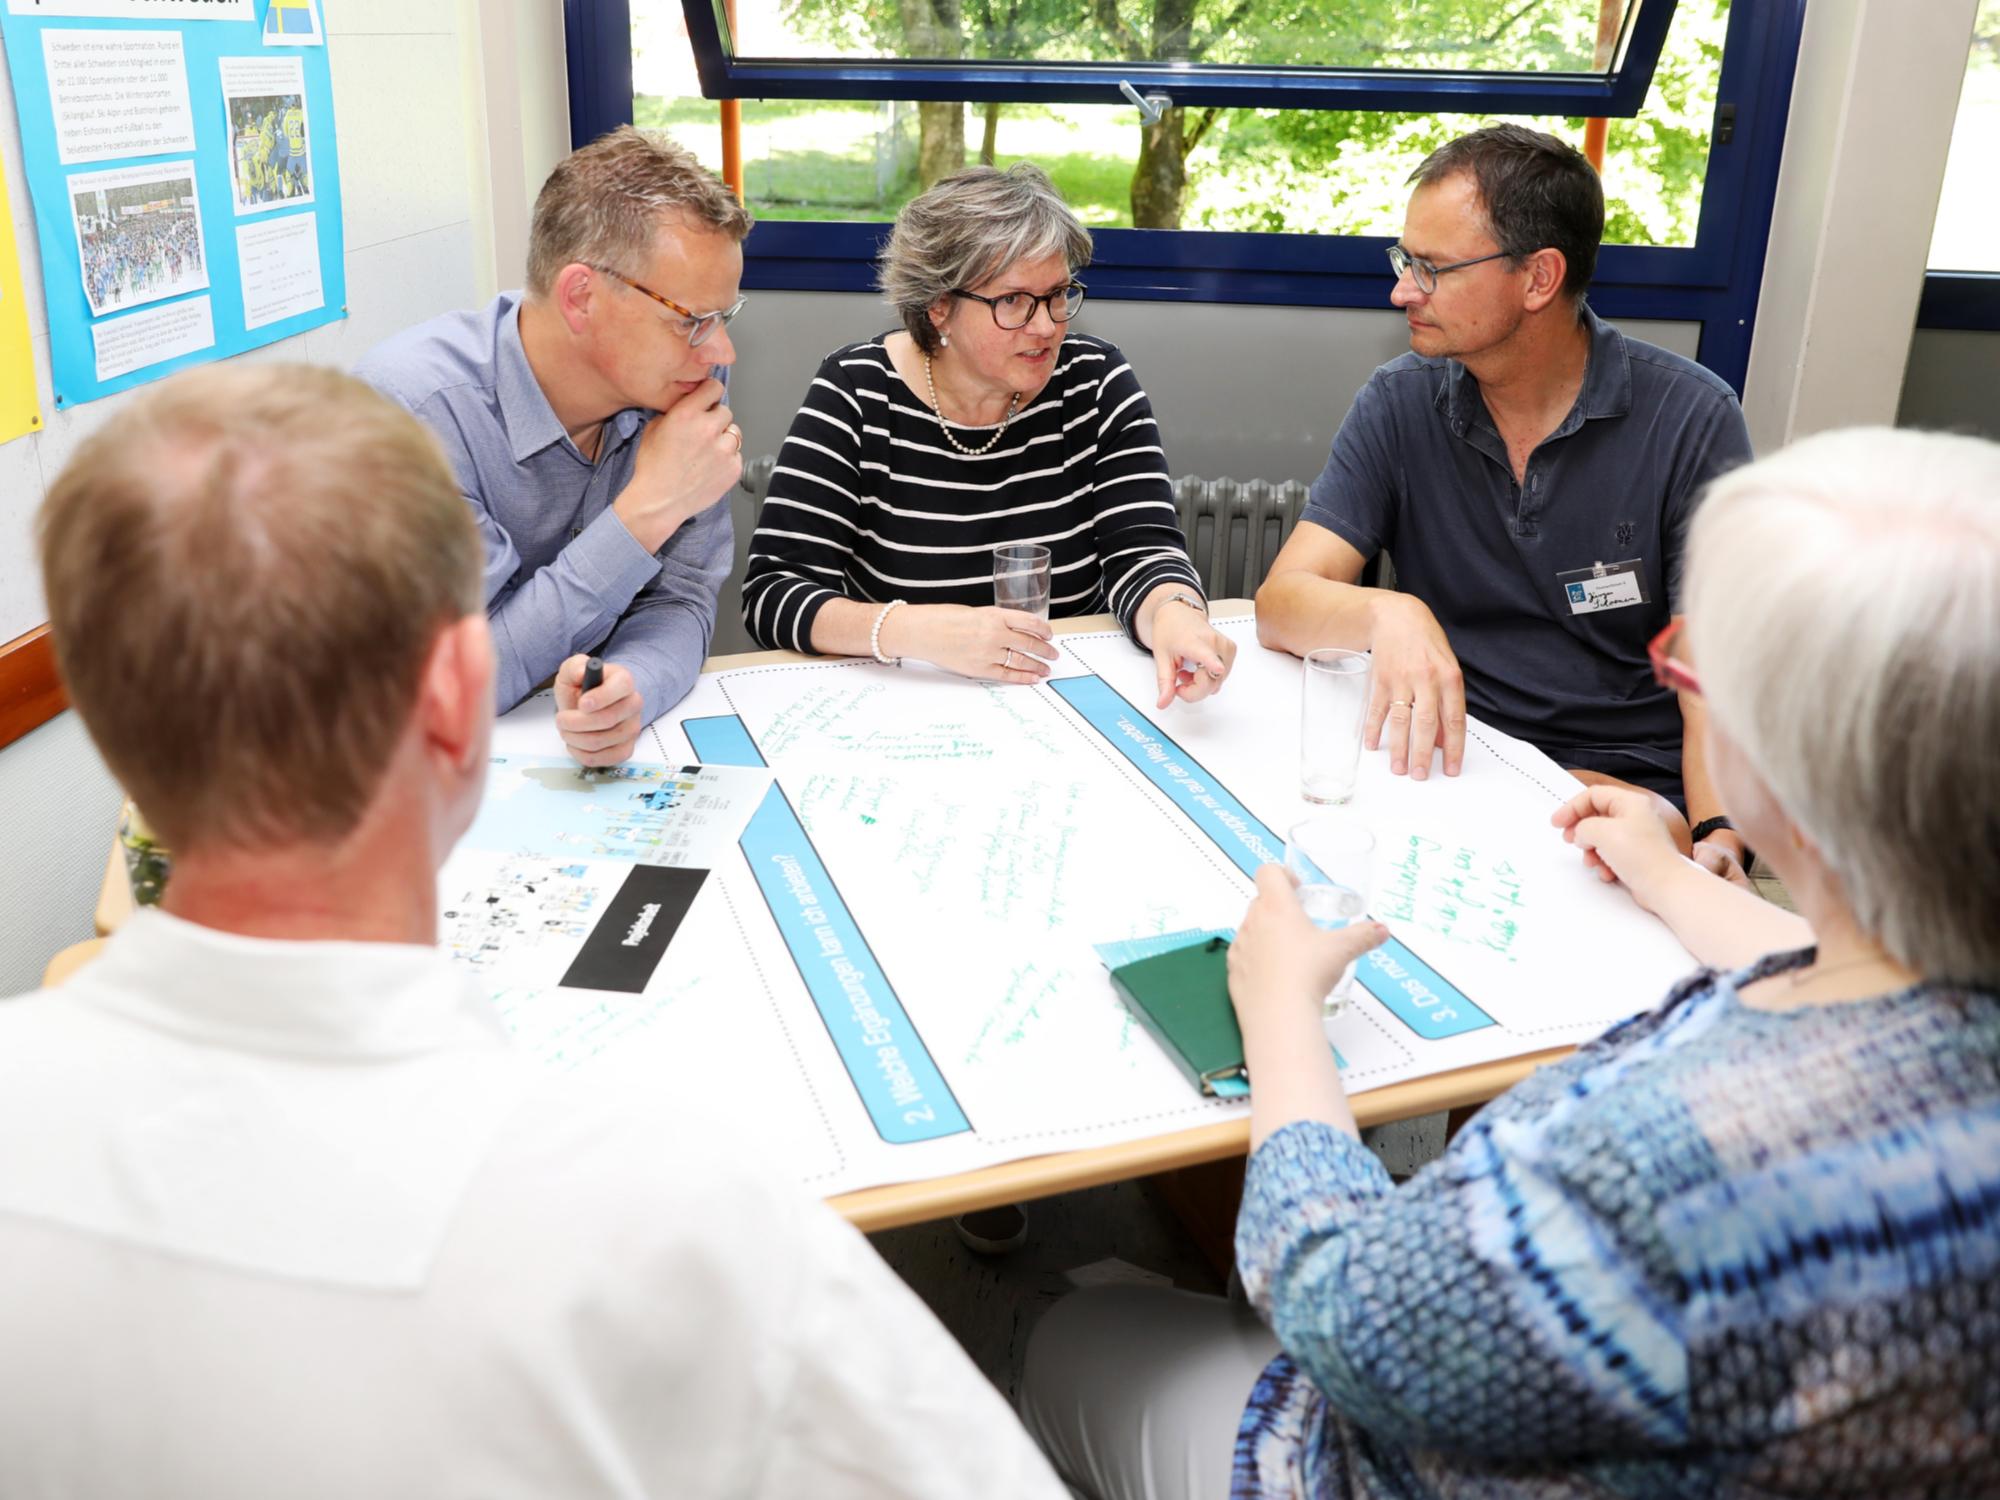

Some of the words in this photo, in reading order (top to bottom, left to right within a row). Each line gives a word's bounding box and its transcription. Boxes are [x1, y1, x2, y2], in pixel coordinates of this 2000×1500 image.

[52, 42, 81, 51] Schweden
[1142, 741, 1170, 763] Weg
[1164, 762, 1189, 778] den
[1174, 777, 1206, 794] auf
[1192, 793, 1221, 809] mit
[771, 854, 818, 906] anbieten?
[800, 905, 829, 926] ich
[814, 924, 845, 957] kann
[830, 956, 893, 1046] Ergänzungen
[1400, 978, 1440, 1008] Das
[1431, 1005, 1458, 1022] 3.
[876, 1045, 924, 1106] Welche
